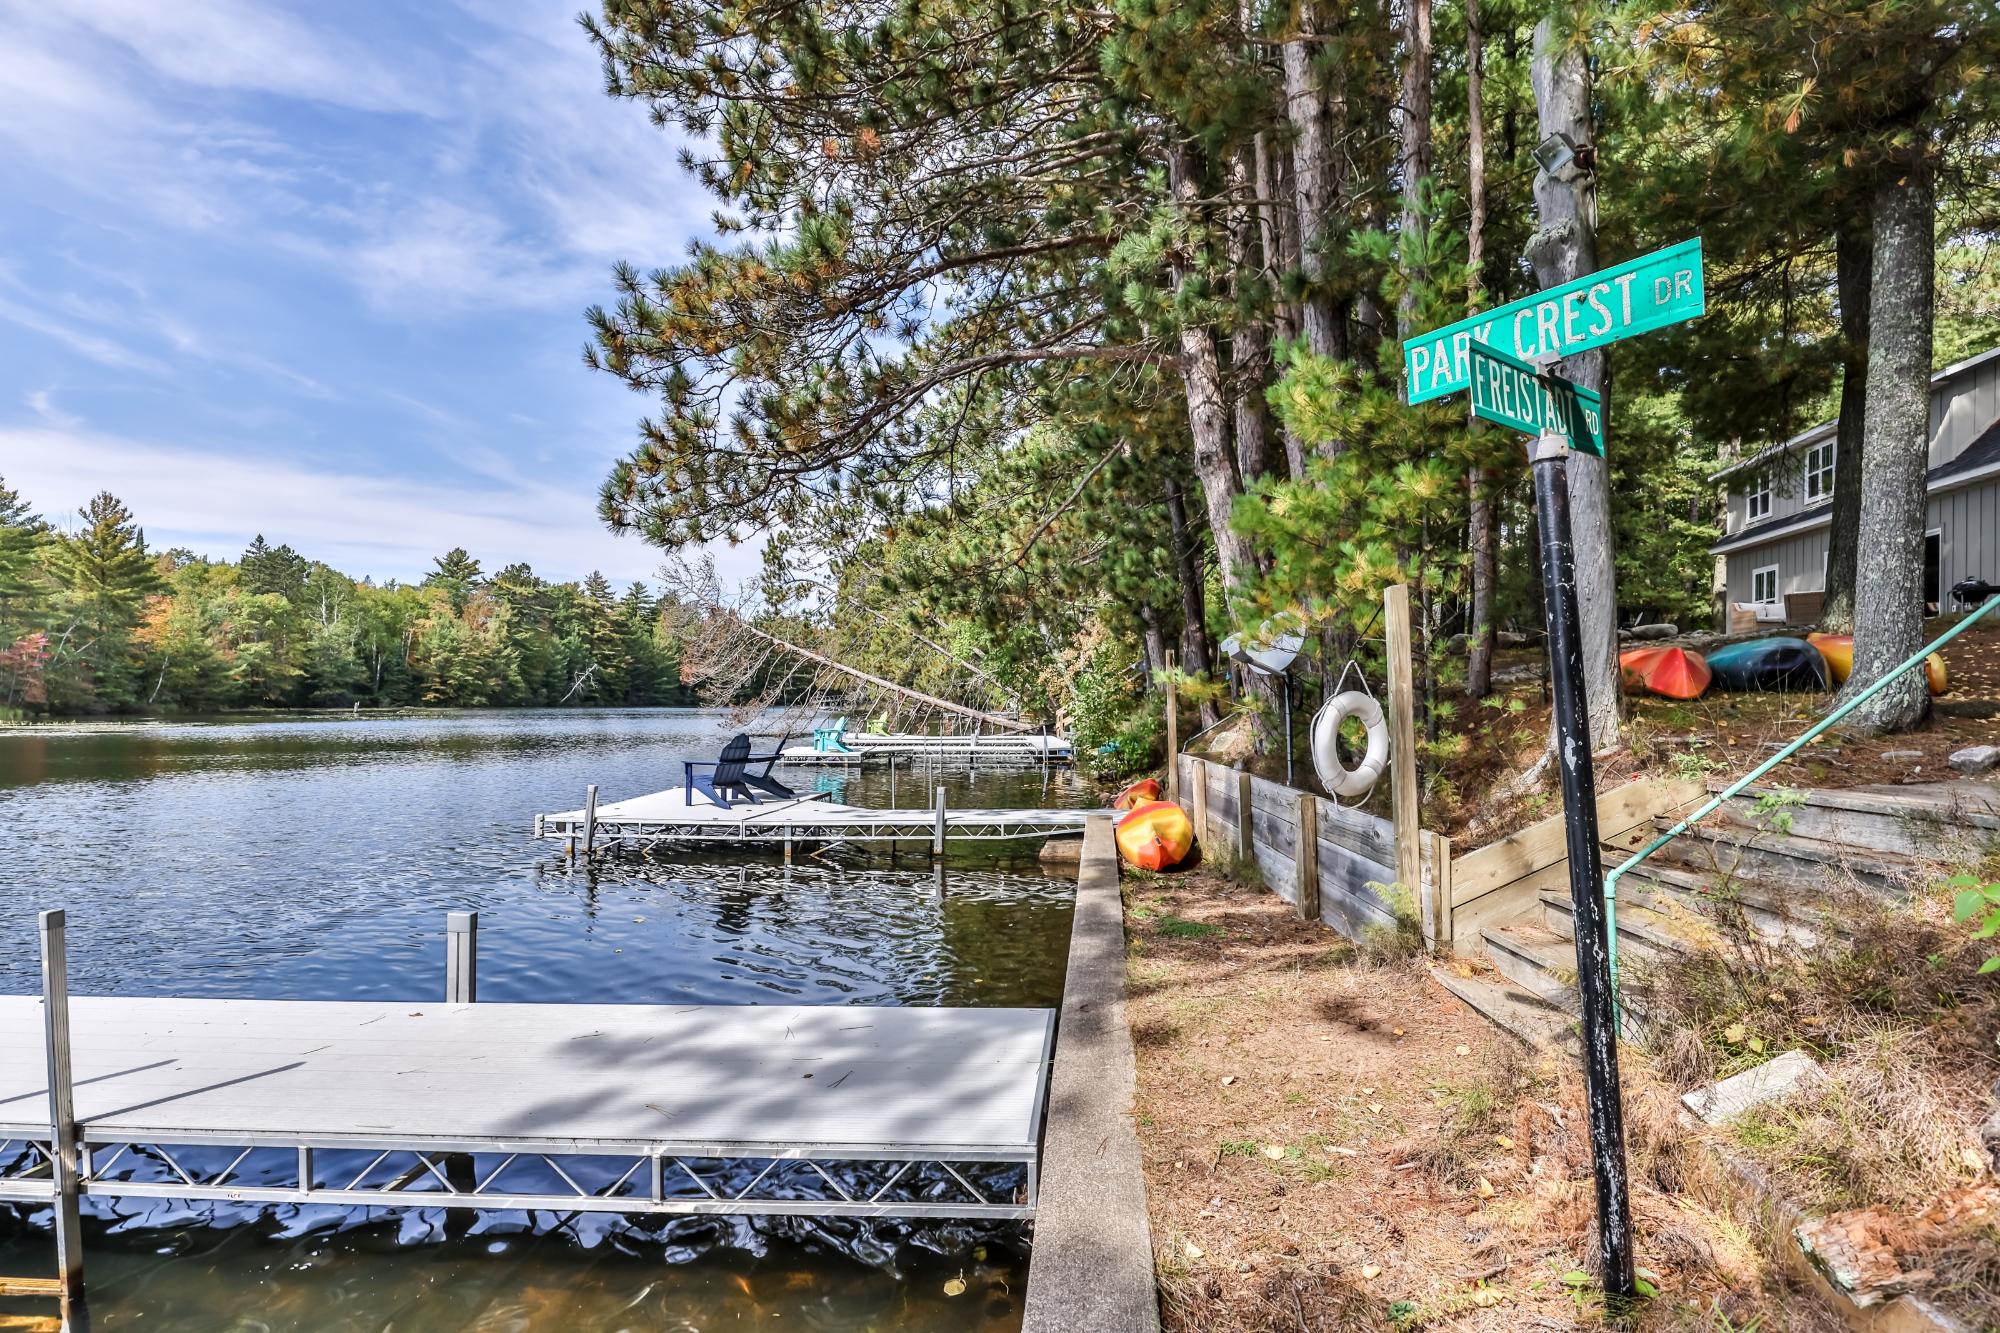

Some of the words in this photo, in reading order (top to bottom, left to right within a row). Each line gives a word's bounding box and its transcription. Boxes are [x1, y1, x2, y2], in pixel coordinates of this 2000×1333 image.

[1513, 272, 1637, 360] CREST
[1654, 269, 1693, 305] DR
[1475, 354, 1574, 438] FREISTADT
[1585, 409, 1599, 436] RD
